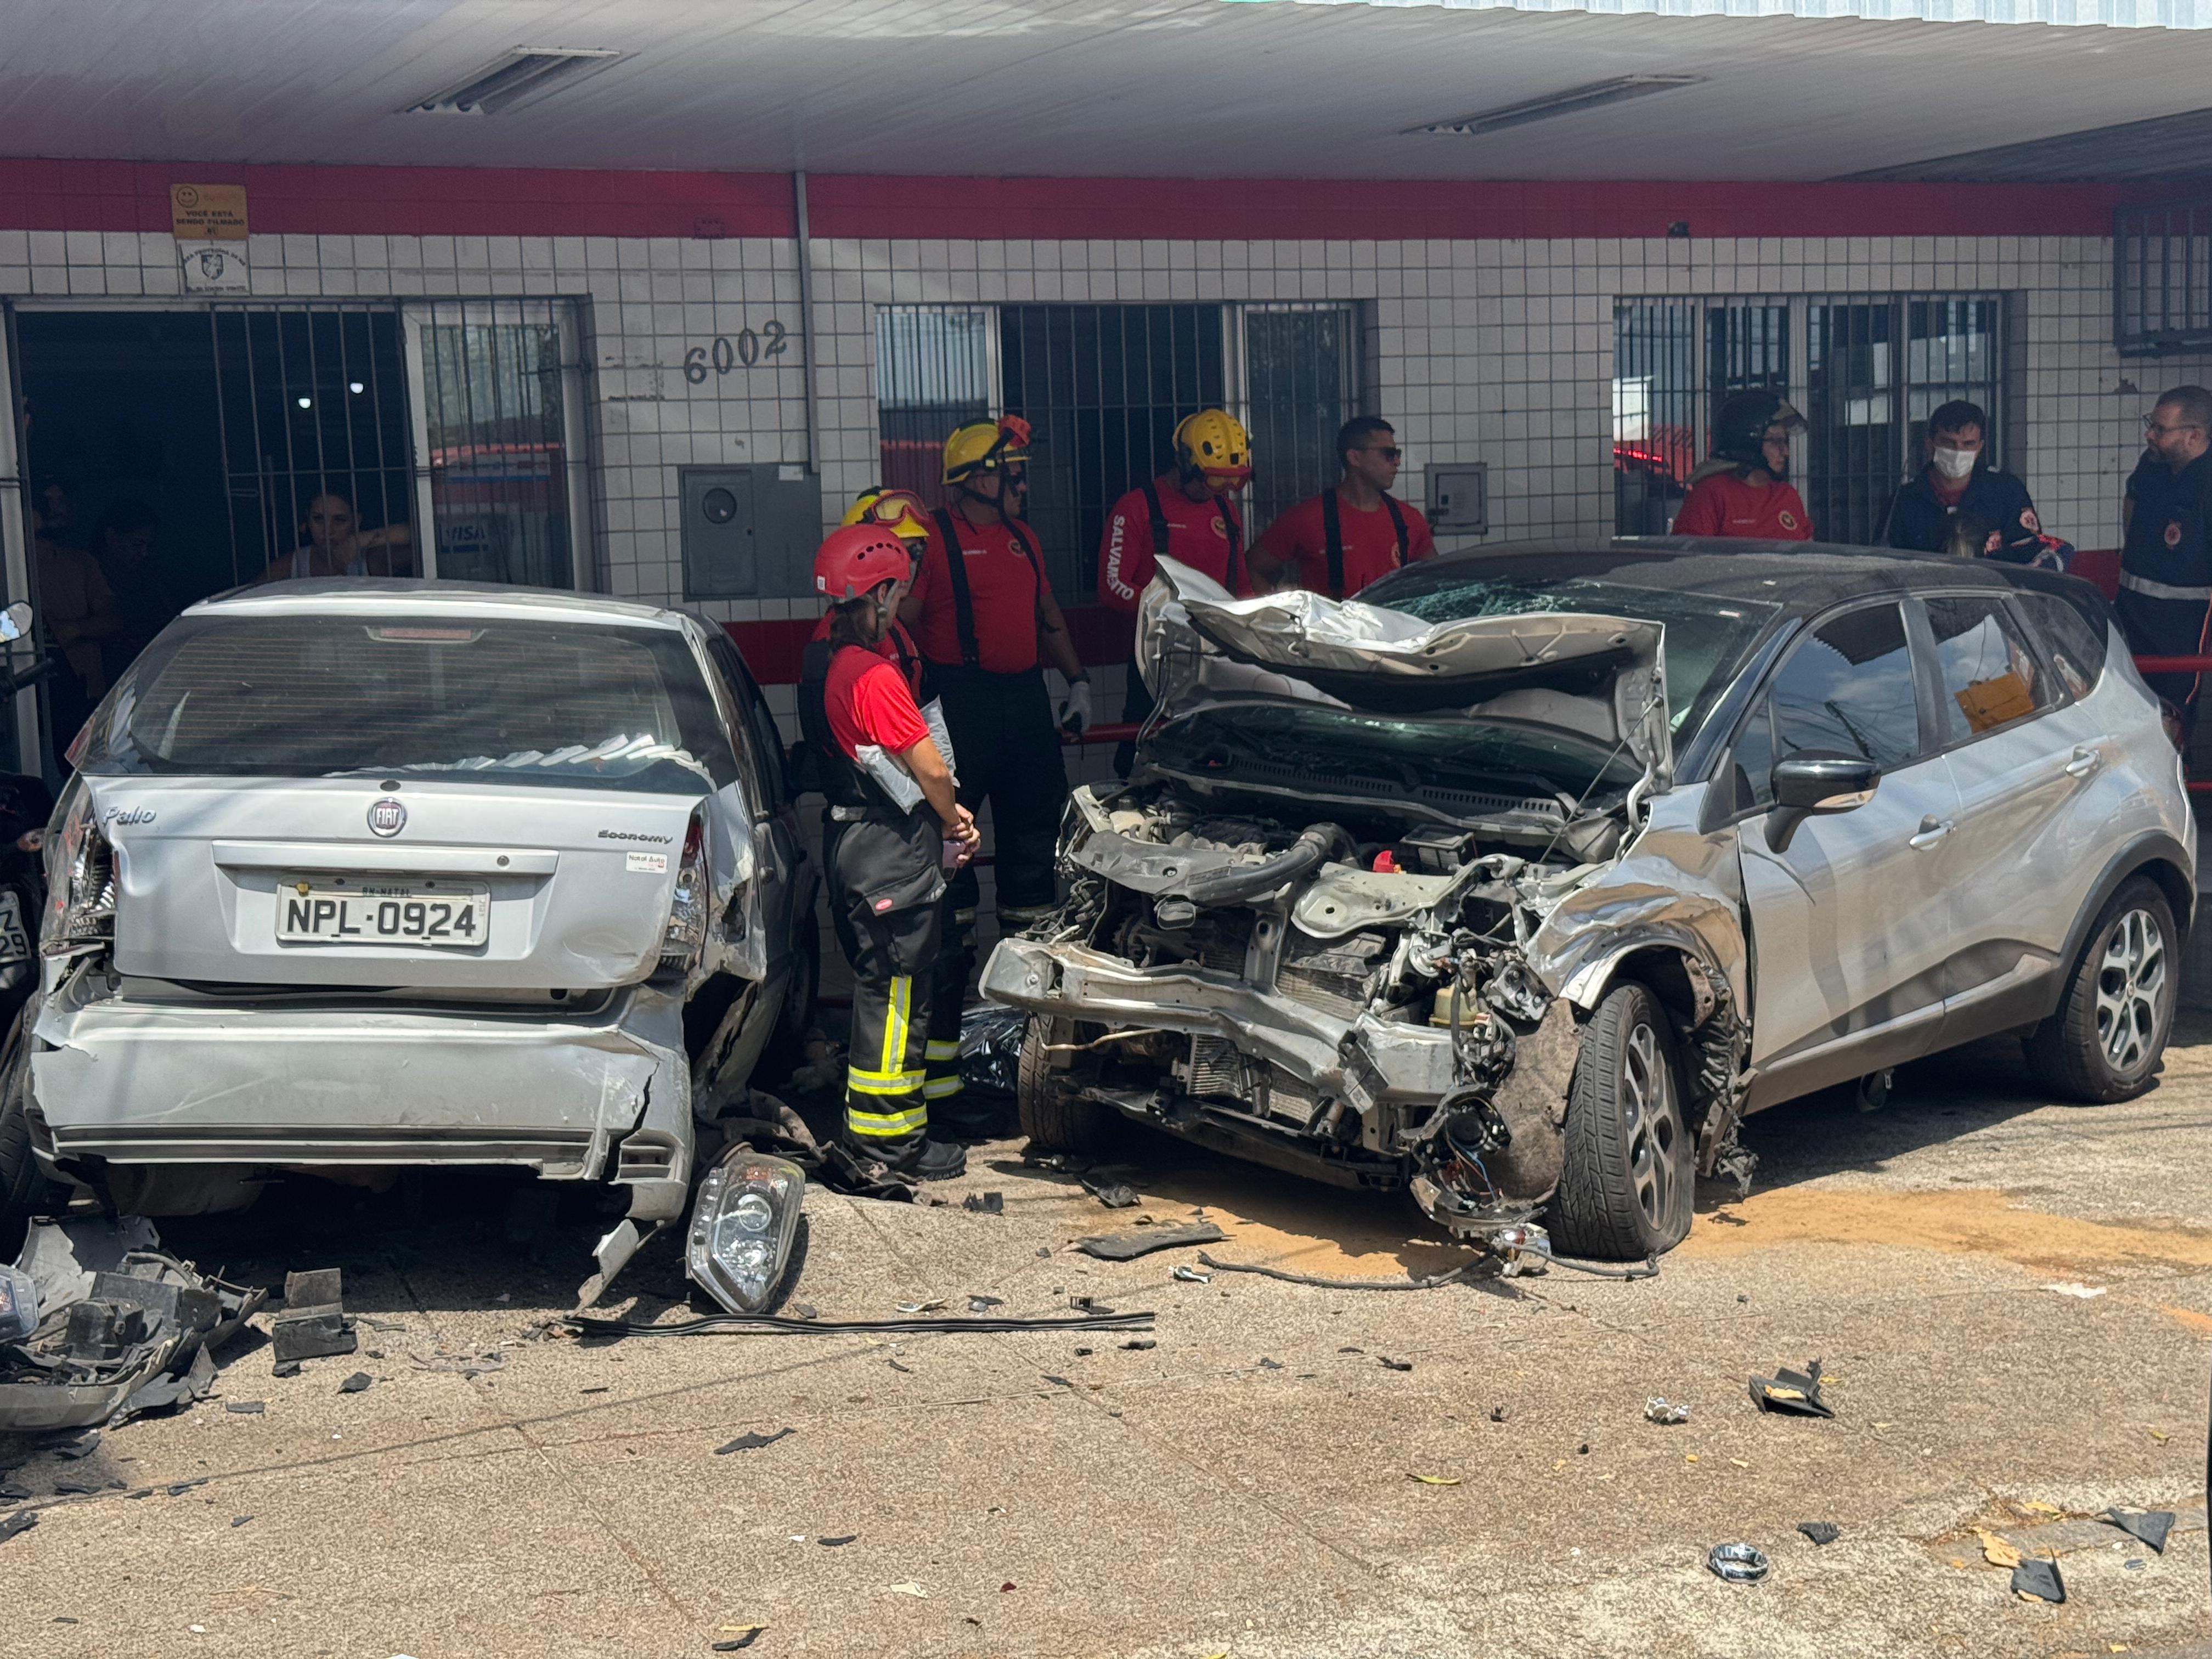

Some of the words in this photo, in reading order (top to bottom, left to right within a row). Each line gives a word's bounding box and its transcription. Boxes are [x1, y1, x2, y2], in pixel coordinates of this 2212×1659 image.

[684, 320, 787, 384] 6002
[446, 526, 485, 540] VISA
[1107, 515, 1135, 600] SALVAMENTO
[103, 805, 157, 828] Palio
[376, 808, 399, 826] FIAT
[597, 830, 674, 845] Economy
